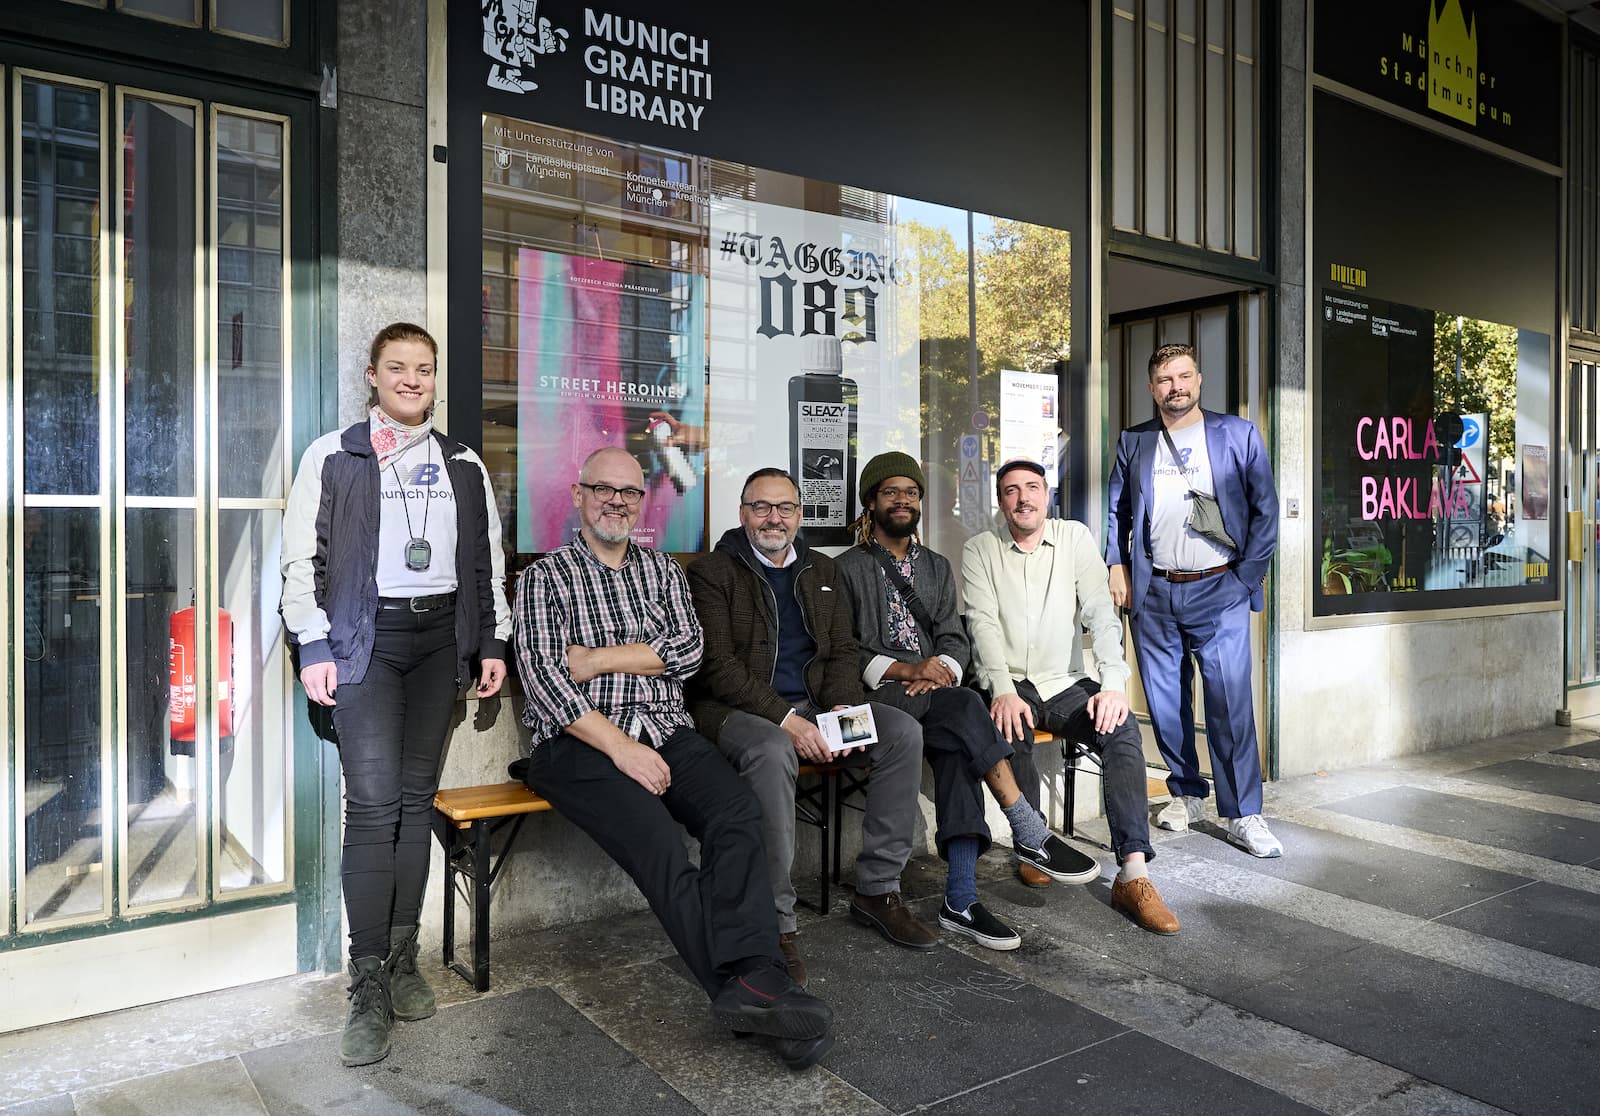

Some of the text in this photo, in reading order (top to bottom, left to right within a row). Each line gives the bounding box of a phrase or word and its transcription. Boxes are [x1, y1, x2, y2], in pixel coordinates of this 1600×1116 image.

[584, 7, 709, 66] MUNICH
[584, 45, 713, 101] GRAFFITI
[1402, 32, 1496, 89] Münchner
[585, 79, 705, 131] LIBRARY
[1380, 56, 1512, 126] Stadtmuseum
[494, 126, 614, 159] Mit Unterstützung von
[525, 163, 571, 181] München
[526, 152, 609, 177] Landeshauptstadt
[626, 170, 698, 193] Kompetenzteam
[626, 192, 668, 208] München
[602, 280, 624, 289] CINEMA
[756, 271, 879, 345] 089
[540, 375, 688, 399] STREET HEROINES
[801, 404, 847, 417] SLEAZY
[1355, 415, 1440, 461] CARLA
[1360, 475, 1471, 521] BAKLAVA
